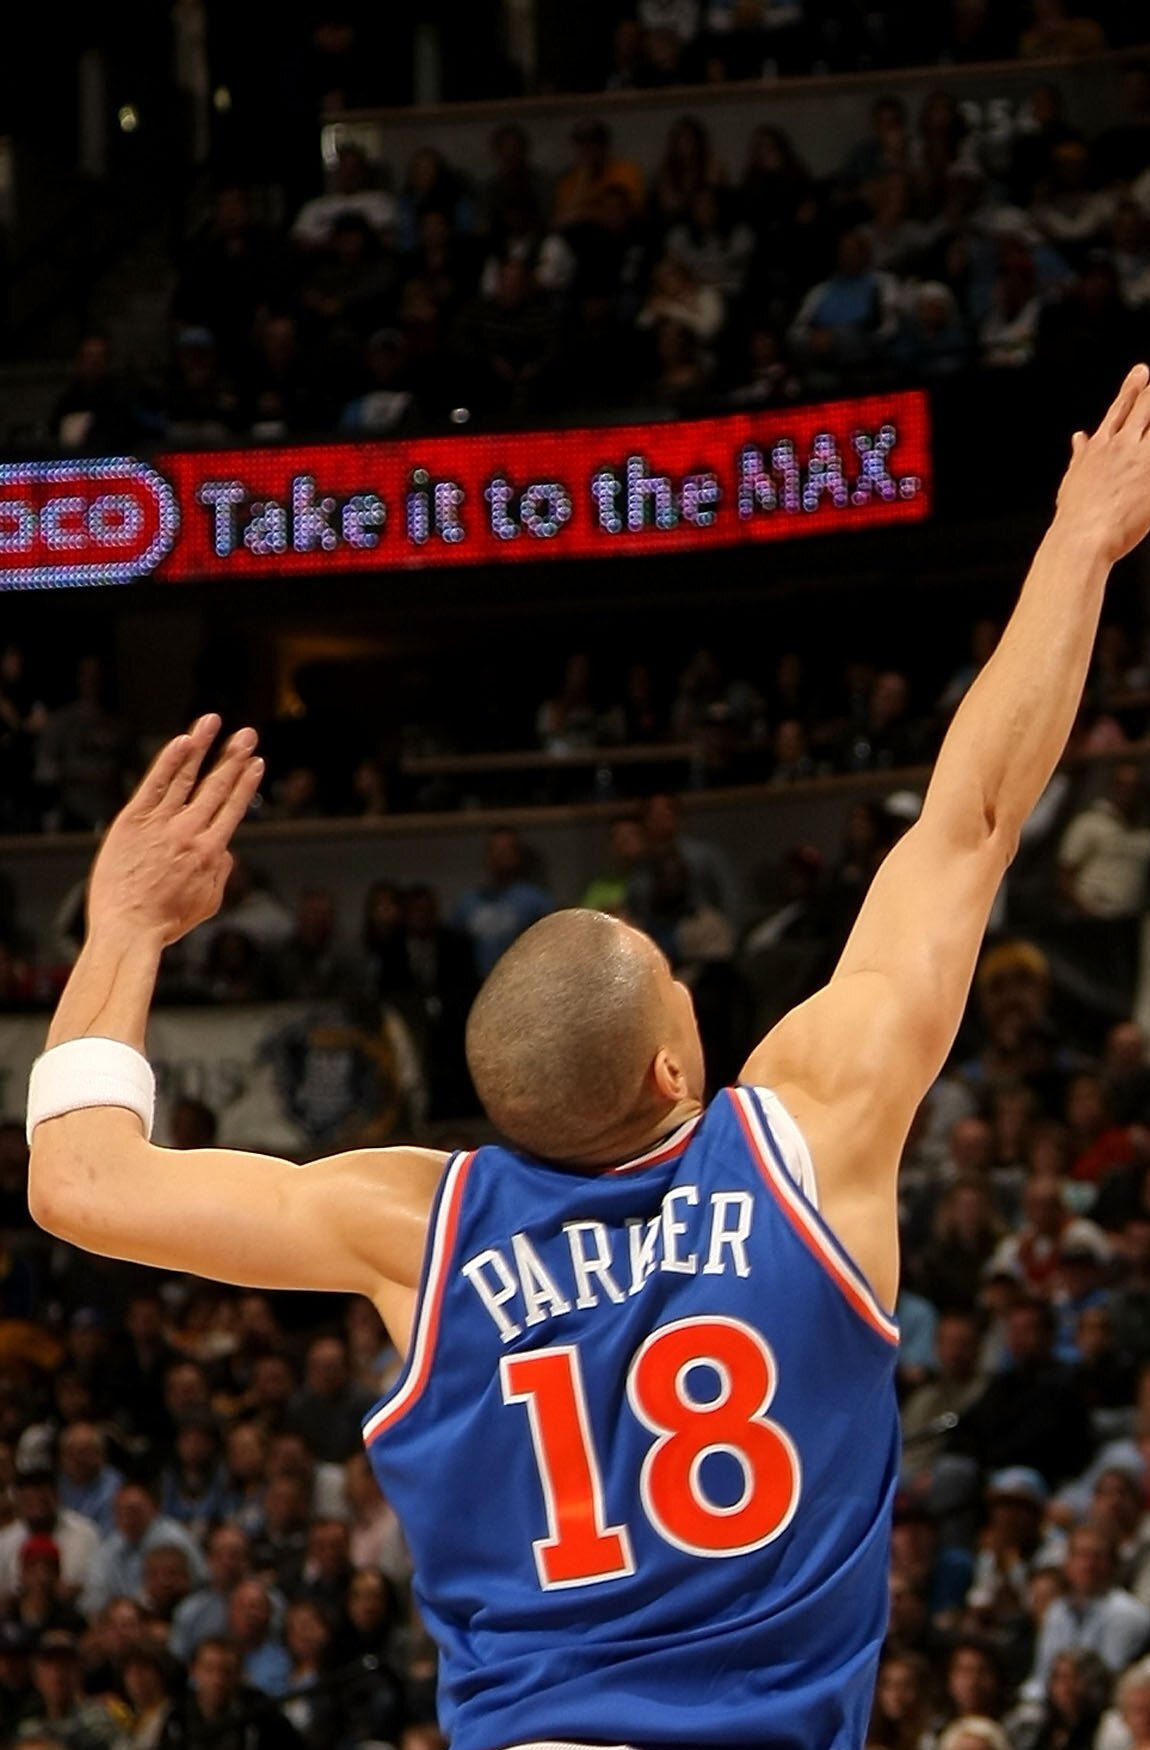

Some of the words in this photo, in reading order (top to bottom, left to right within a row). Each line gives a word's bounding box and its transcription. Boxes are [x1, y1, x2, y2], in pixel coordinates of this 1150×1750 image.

[201, 476, 387, 556] Take
[406, 468, 465, 545] it
[485, 480, 571, 540] to
[592, 456, 722, 533] the
[738, 425, 921, 521] MAX.
[462, 1185, 755, 1344] PARKER
[500, 1315, 800, 1591] 18
